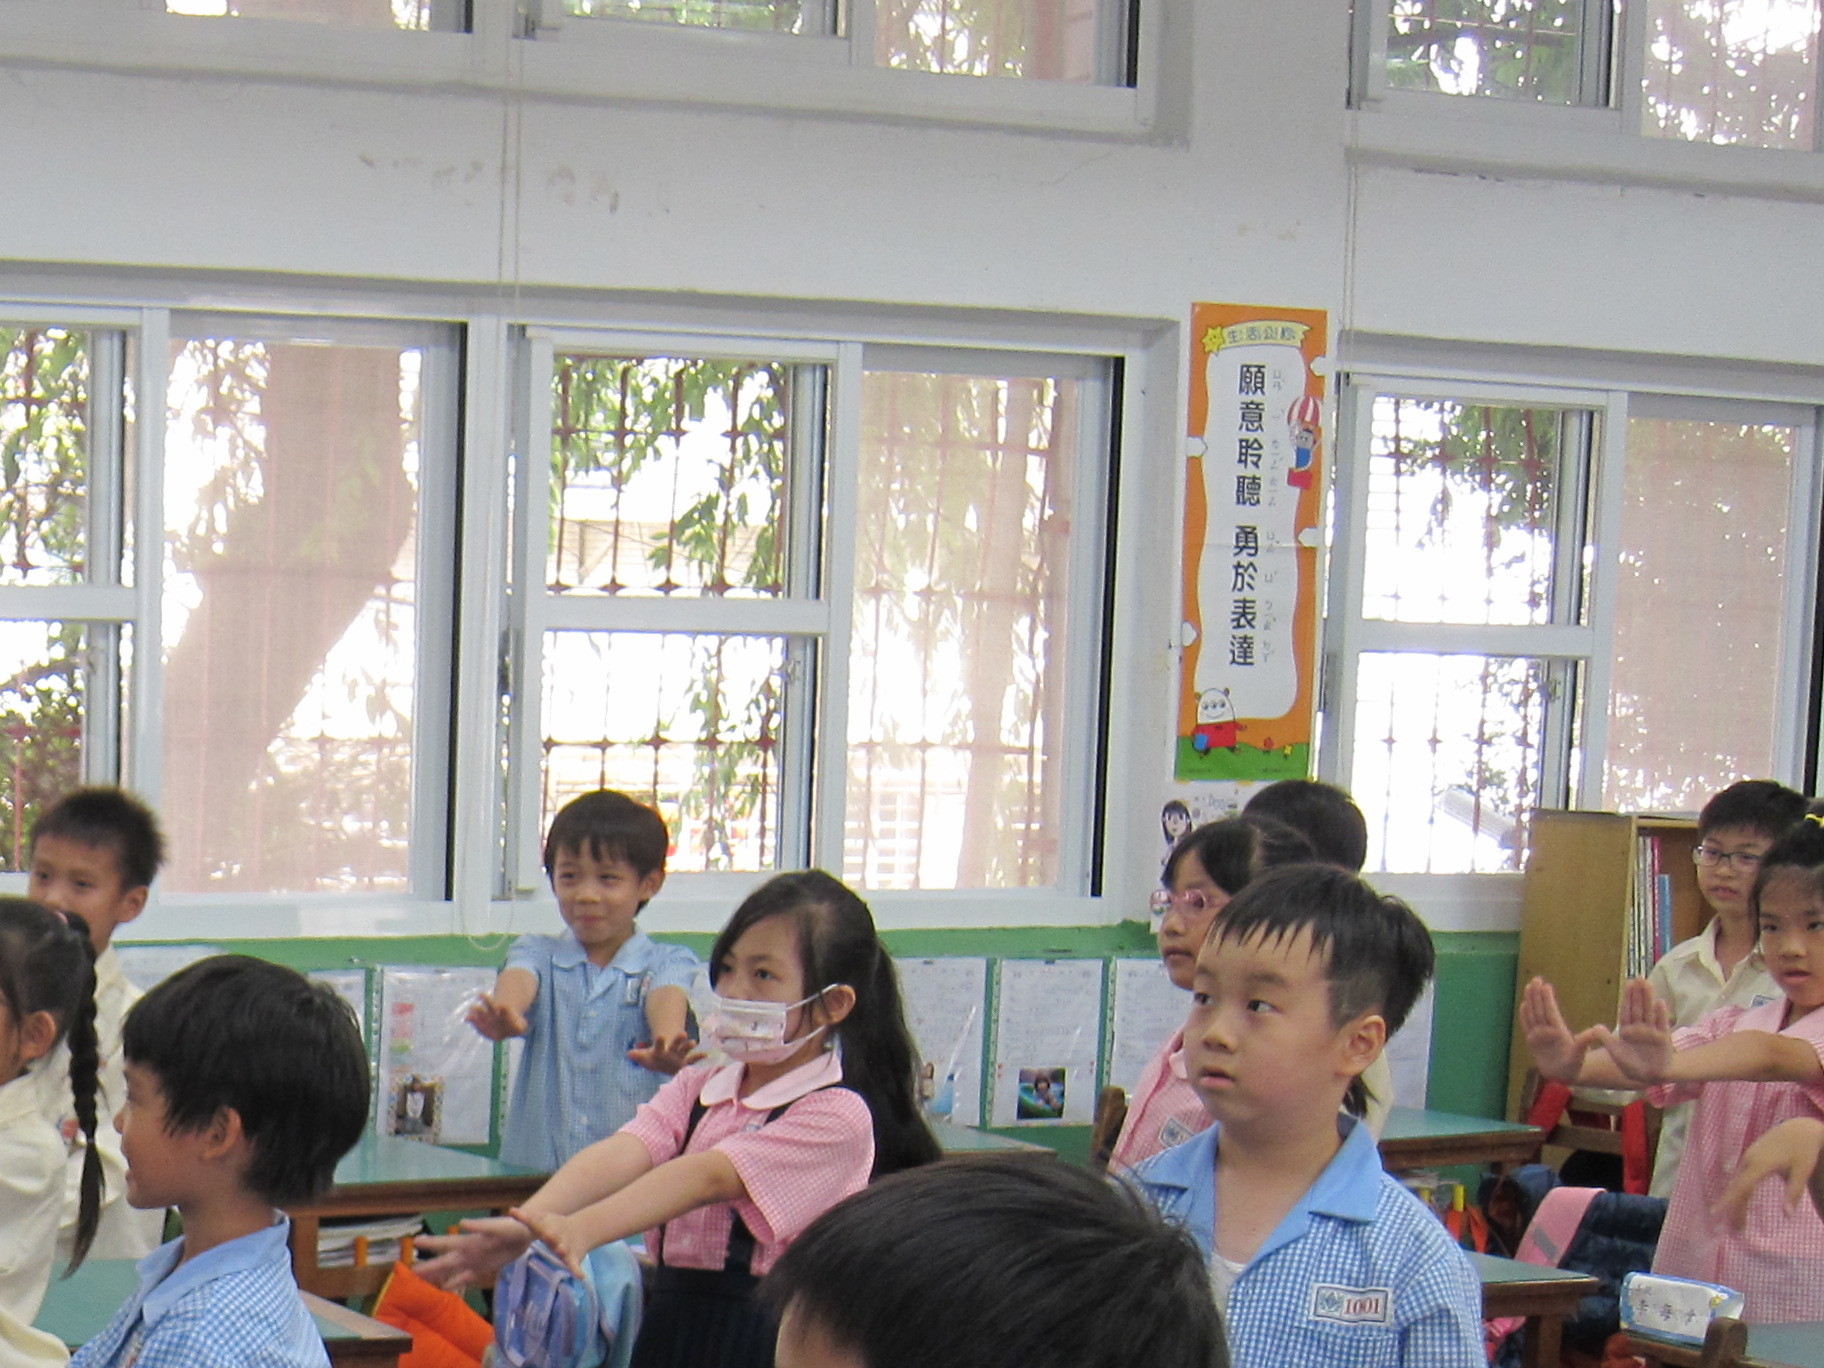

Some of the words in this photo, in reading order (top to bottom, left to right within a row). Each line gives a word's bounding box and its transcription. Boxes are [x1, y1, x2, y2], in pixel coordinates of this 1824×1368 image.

[1235, 363, 1266, 507] 願意聆聽
[1229, 524, 1259, 666] 勇於表達
[1343, 1297, 1380, 1315] 1001
